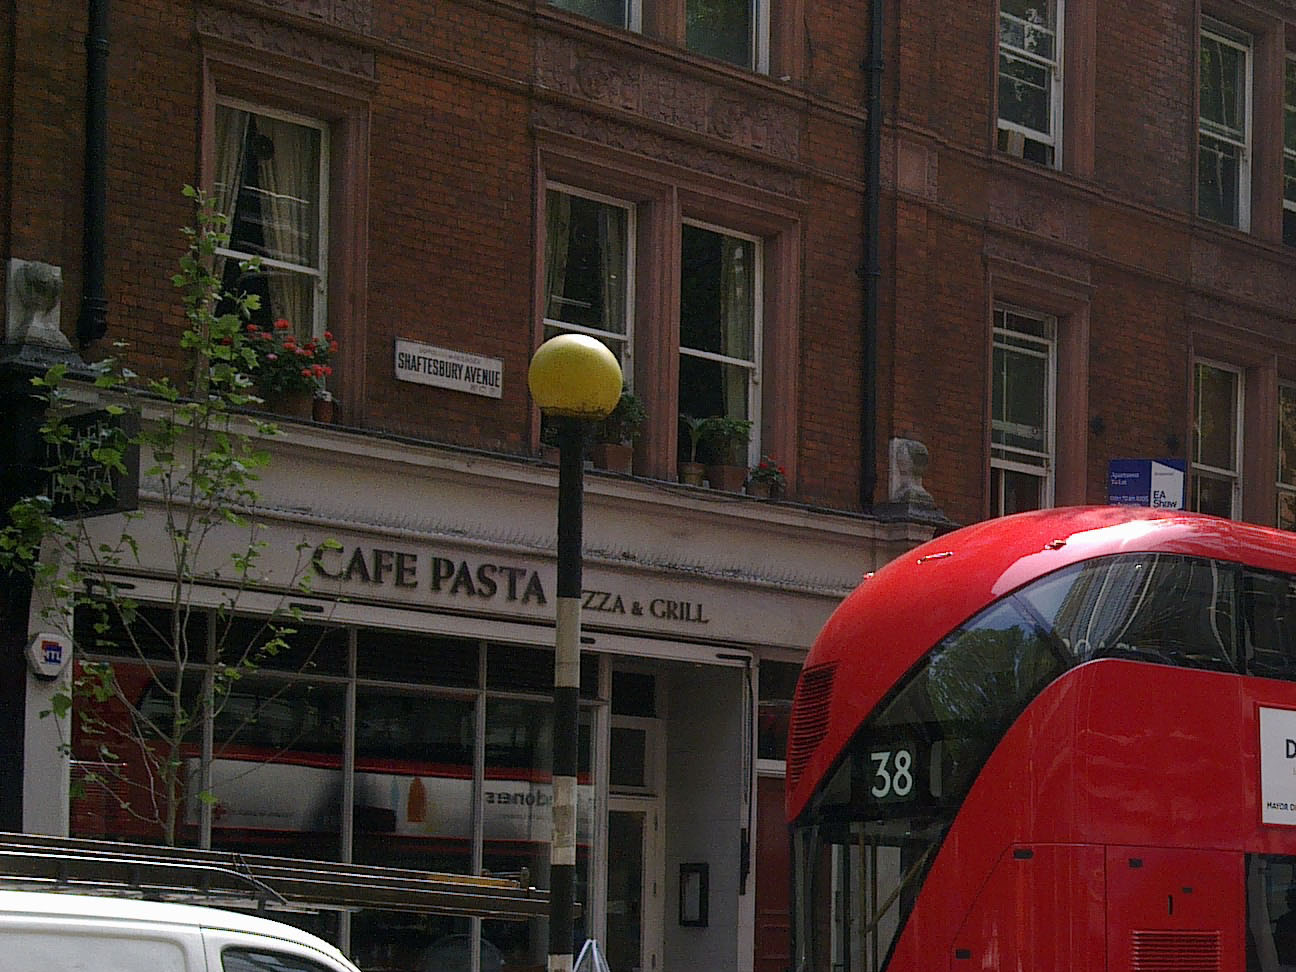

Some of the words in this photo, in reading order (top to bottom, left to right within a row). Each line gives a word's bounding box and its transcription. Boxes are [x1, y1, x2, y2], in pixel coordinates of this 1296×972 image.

[398, 352, 464, 380] SHAFTESBURY
[464, 366, 501, 388] AVENUE
[1153, 490, 1166, 499] EA
[312, 545, 418, 588] CAFE
[430, 556, 547, 604] PASTA
[582, 590, 625, 614] ZZA
[631, 601, 643, 616] &
[650, 598, 709, 624] GRILL
[871, 750, 913, 798] 38
